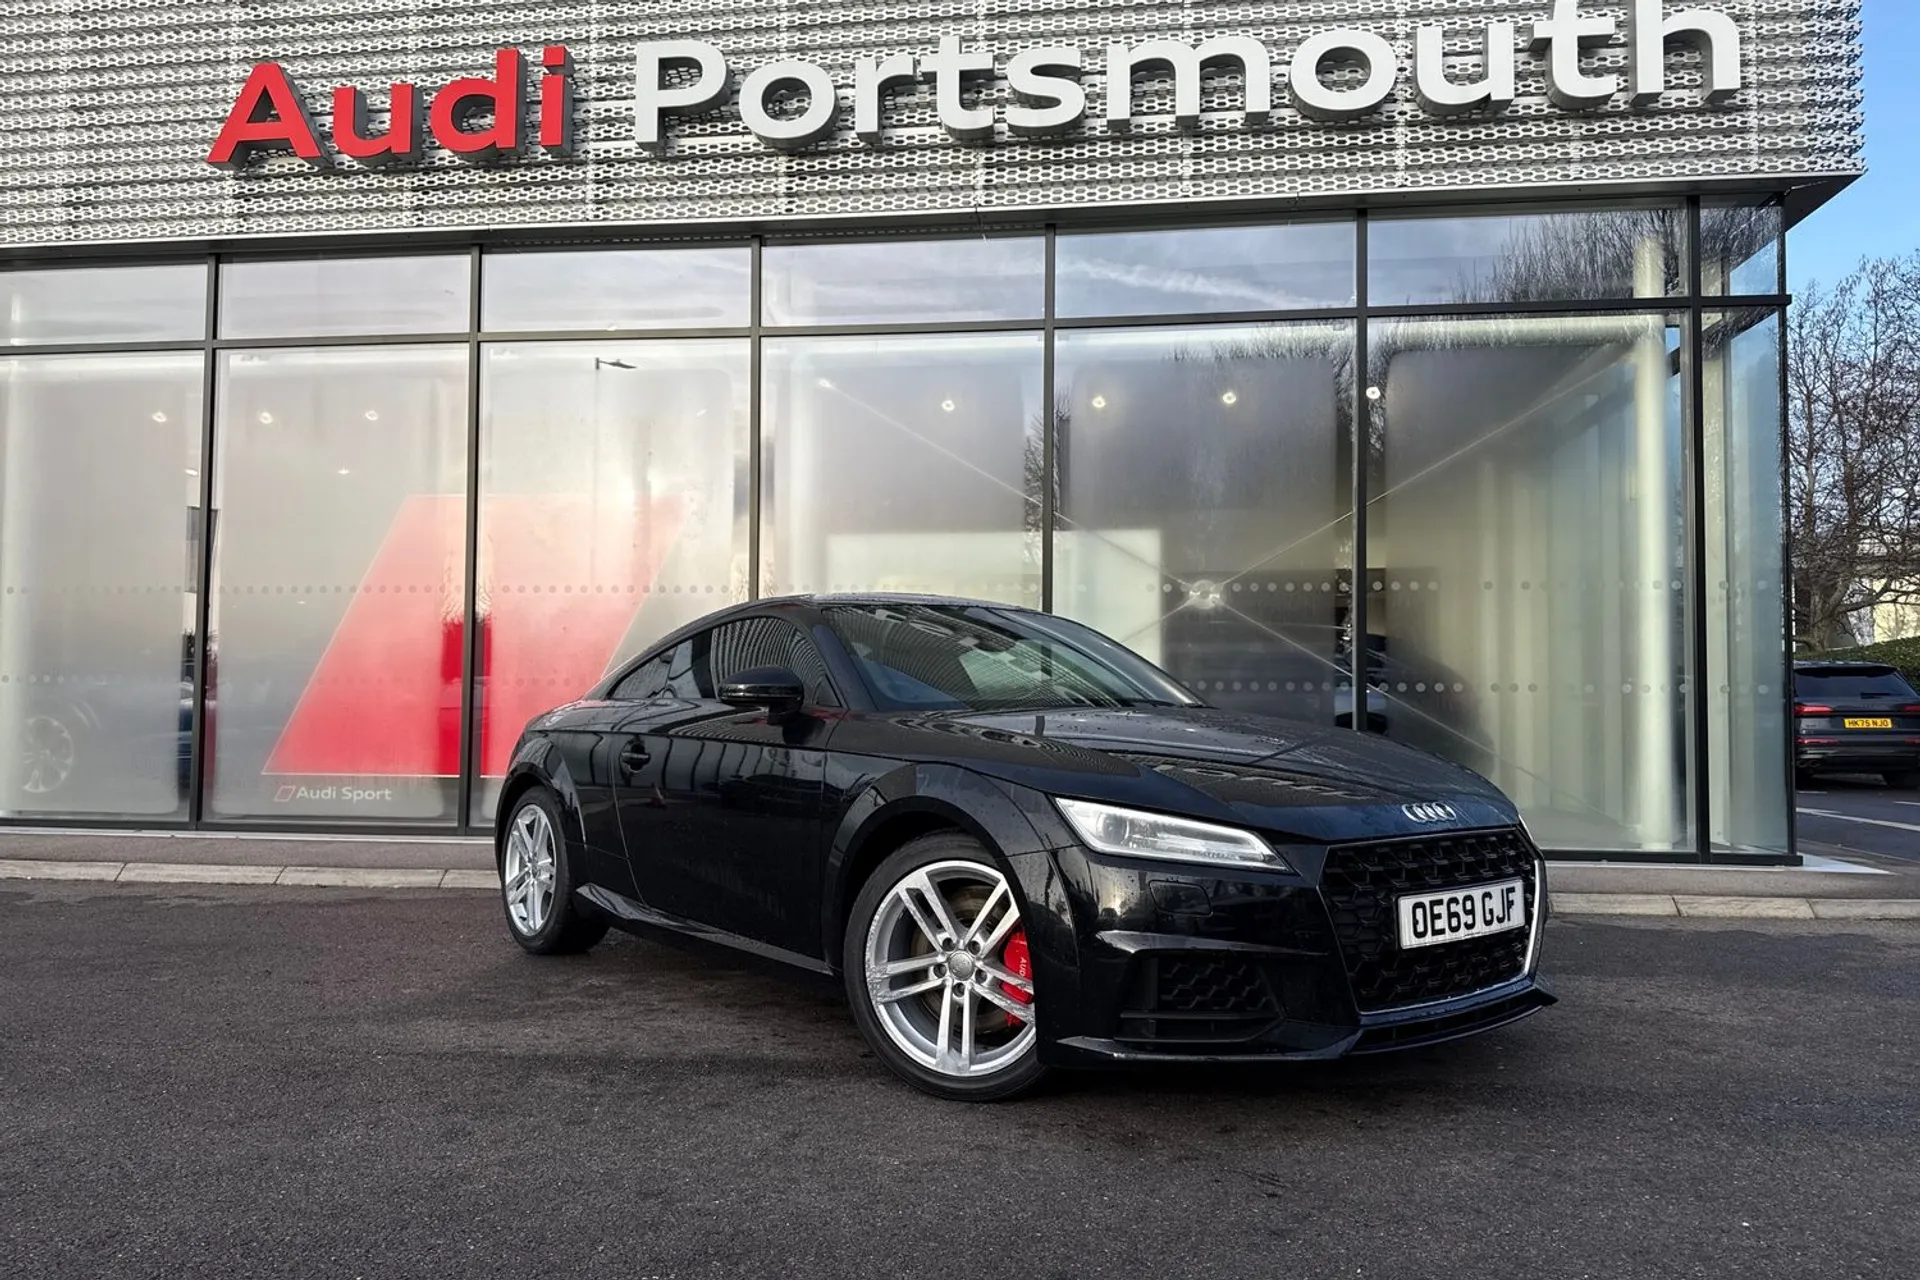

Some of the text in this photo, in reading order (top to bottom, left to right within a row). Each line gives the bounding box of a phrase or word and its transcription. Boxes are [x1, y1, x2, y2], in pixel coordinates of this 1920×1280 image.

[207, 0, 1741, 164] Audi Portsmouth
[1848, 719, 1870, 727] HK75
[296, 786, 392, 803] Audi Sport
[1411, 886, 1516, 939] OE69 GJF
